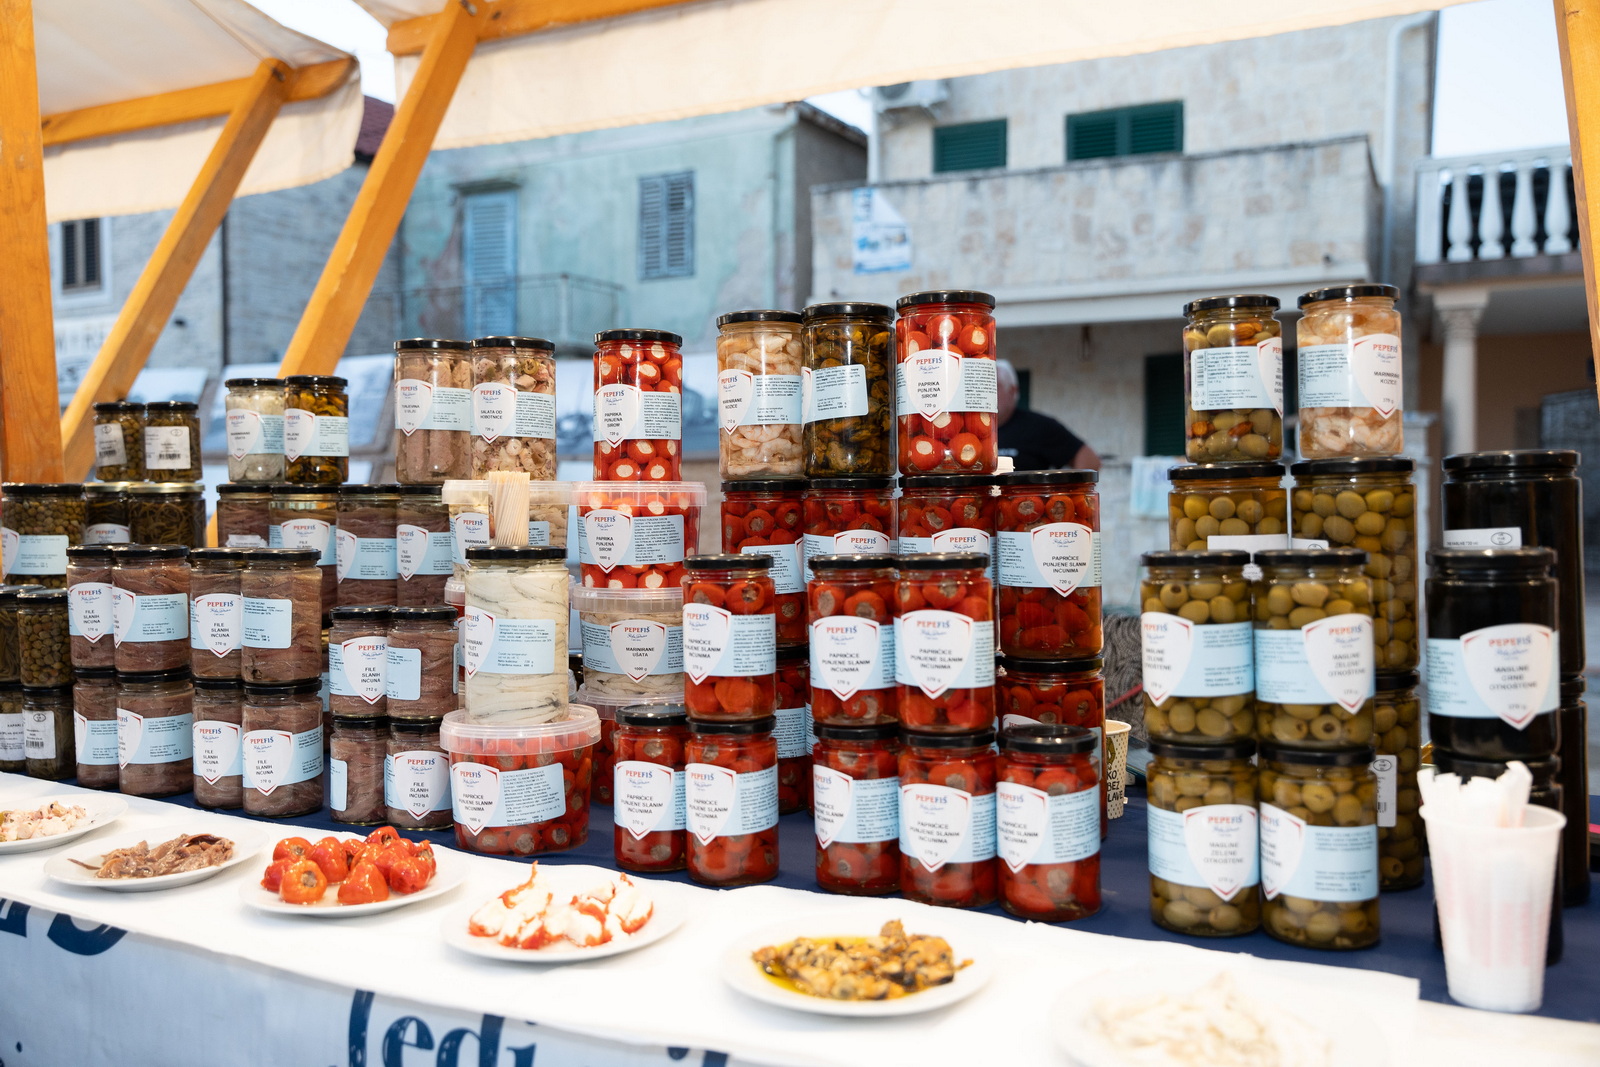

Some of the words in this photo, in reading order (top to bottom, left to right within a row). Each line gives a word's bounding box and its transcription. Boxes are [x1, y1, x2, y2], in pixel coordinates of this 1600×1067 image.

[916, 357, 942, 365] PEPEFIŠ
[1049, 530, 1078, 538] PEPEFIŠ
[687, 612, 709, 620] PEPEFIŠ
[917, 620, 950, 628] PEPEFIŠ
[827, 626, 857, 634] PEPEFIŠ
[1489, 635, 1531, 647] PEPEFIŠ
[626, 770, 653, 778] PEPEFIŠ
[691, 772, 714, 780] PEPEFIŠ
[1108, 781, 1120, 792] BEZ
[916, 794, 947, 803] PEPEFIŠ
[1208, 814, 1242, 824] PEPEFIŠ
